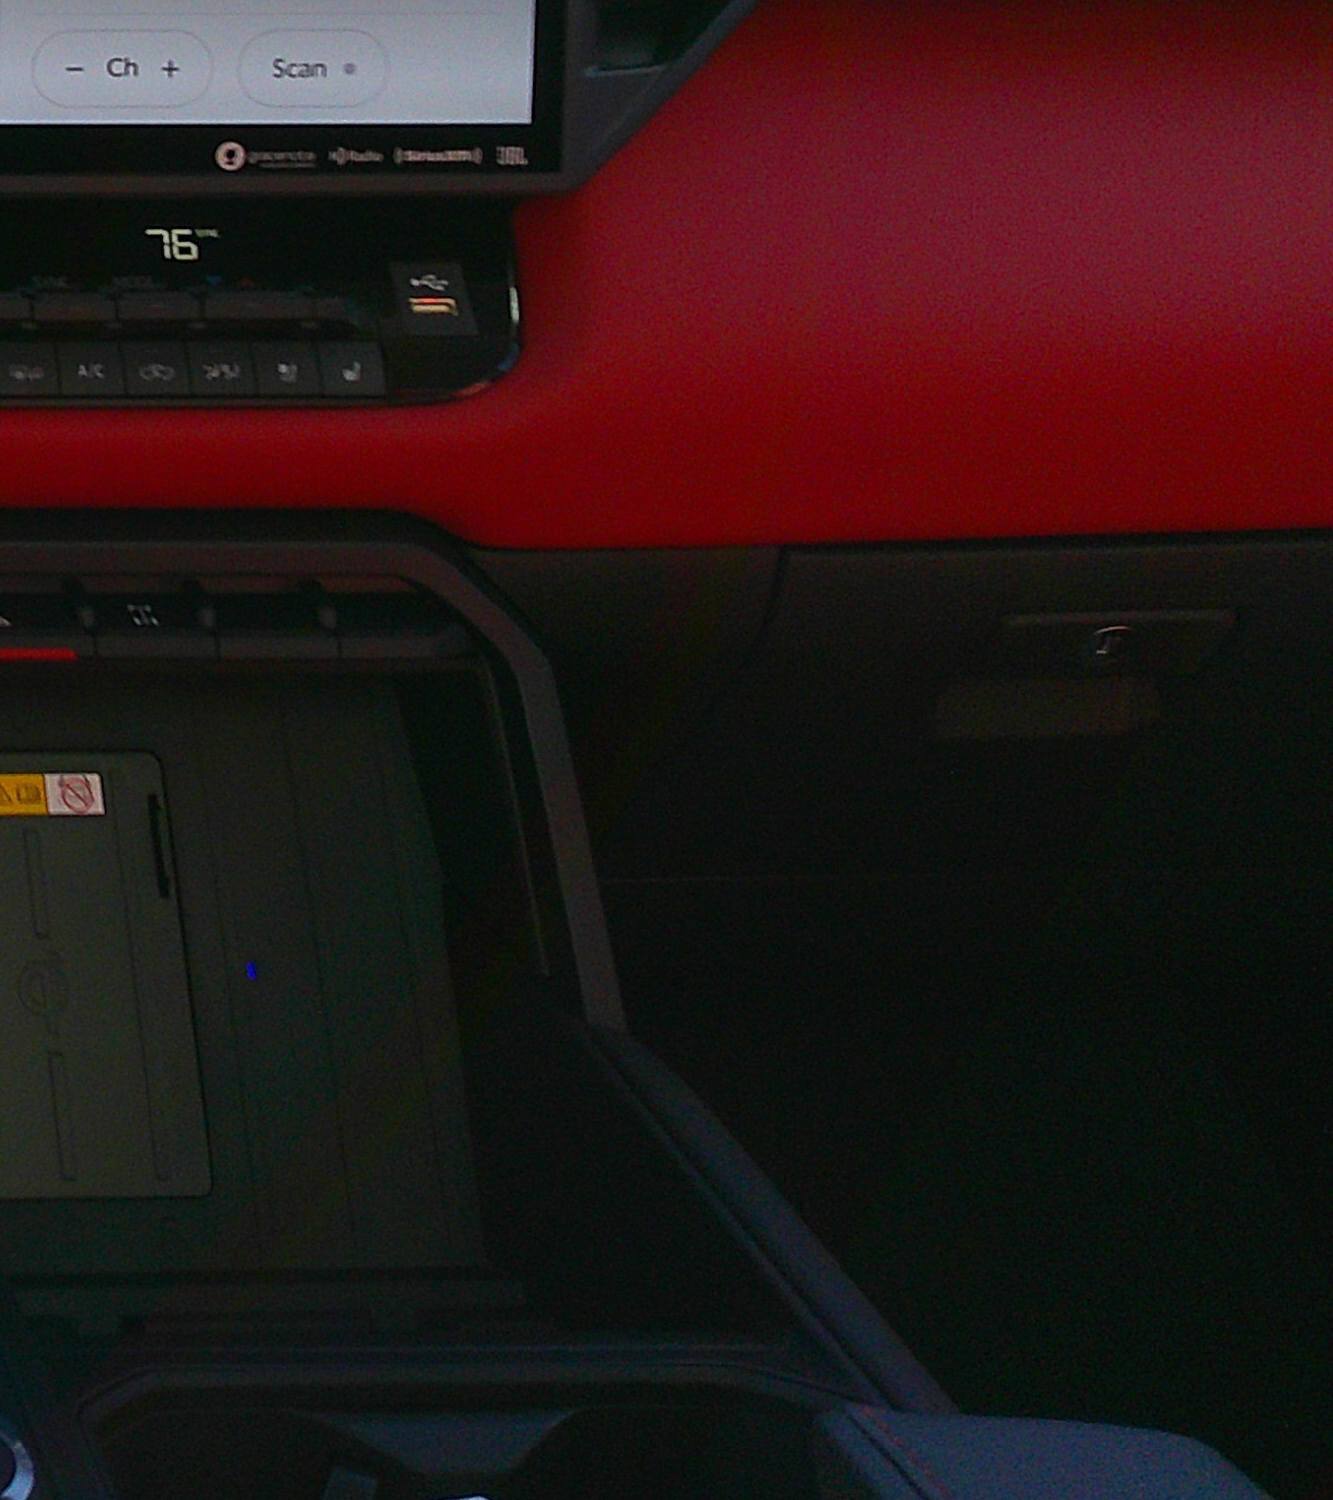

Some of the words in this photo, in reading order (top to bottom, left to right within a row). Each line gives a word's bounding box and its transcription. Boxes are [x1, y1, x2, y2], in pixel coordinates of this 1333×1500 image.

[106, 57, 140, 79] Ch
[272, 58, 328, 79] Scan
[144, 228, 200, 261] 76
